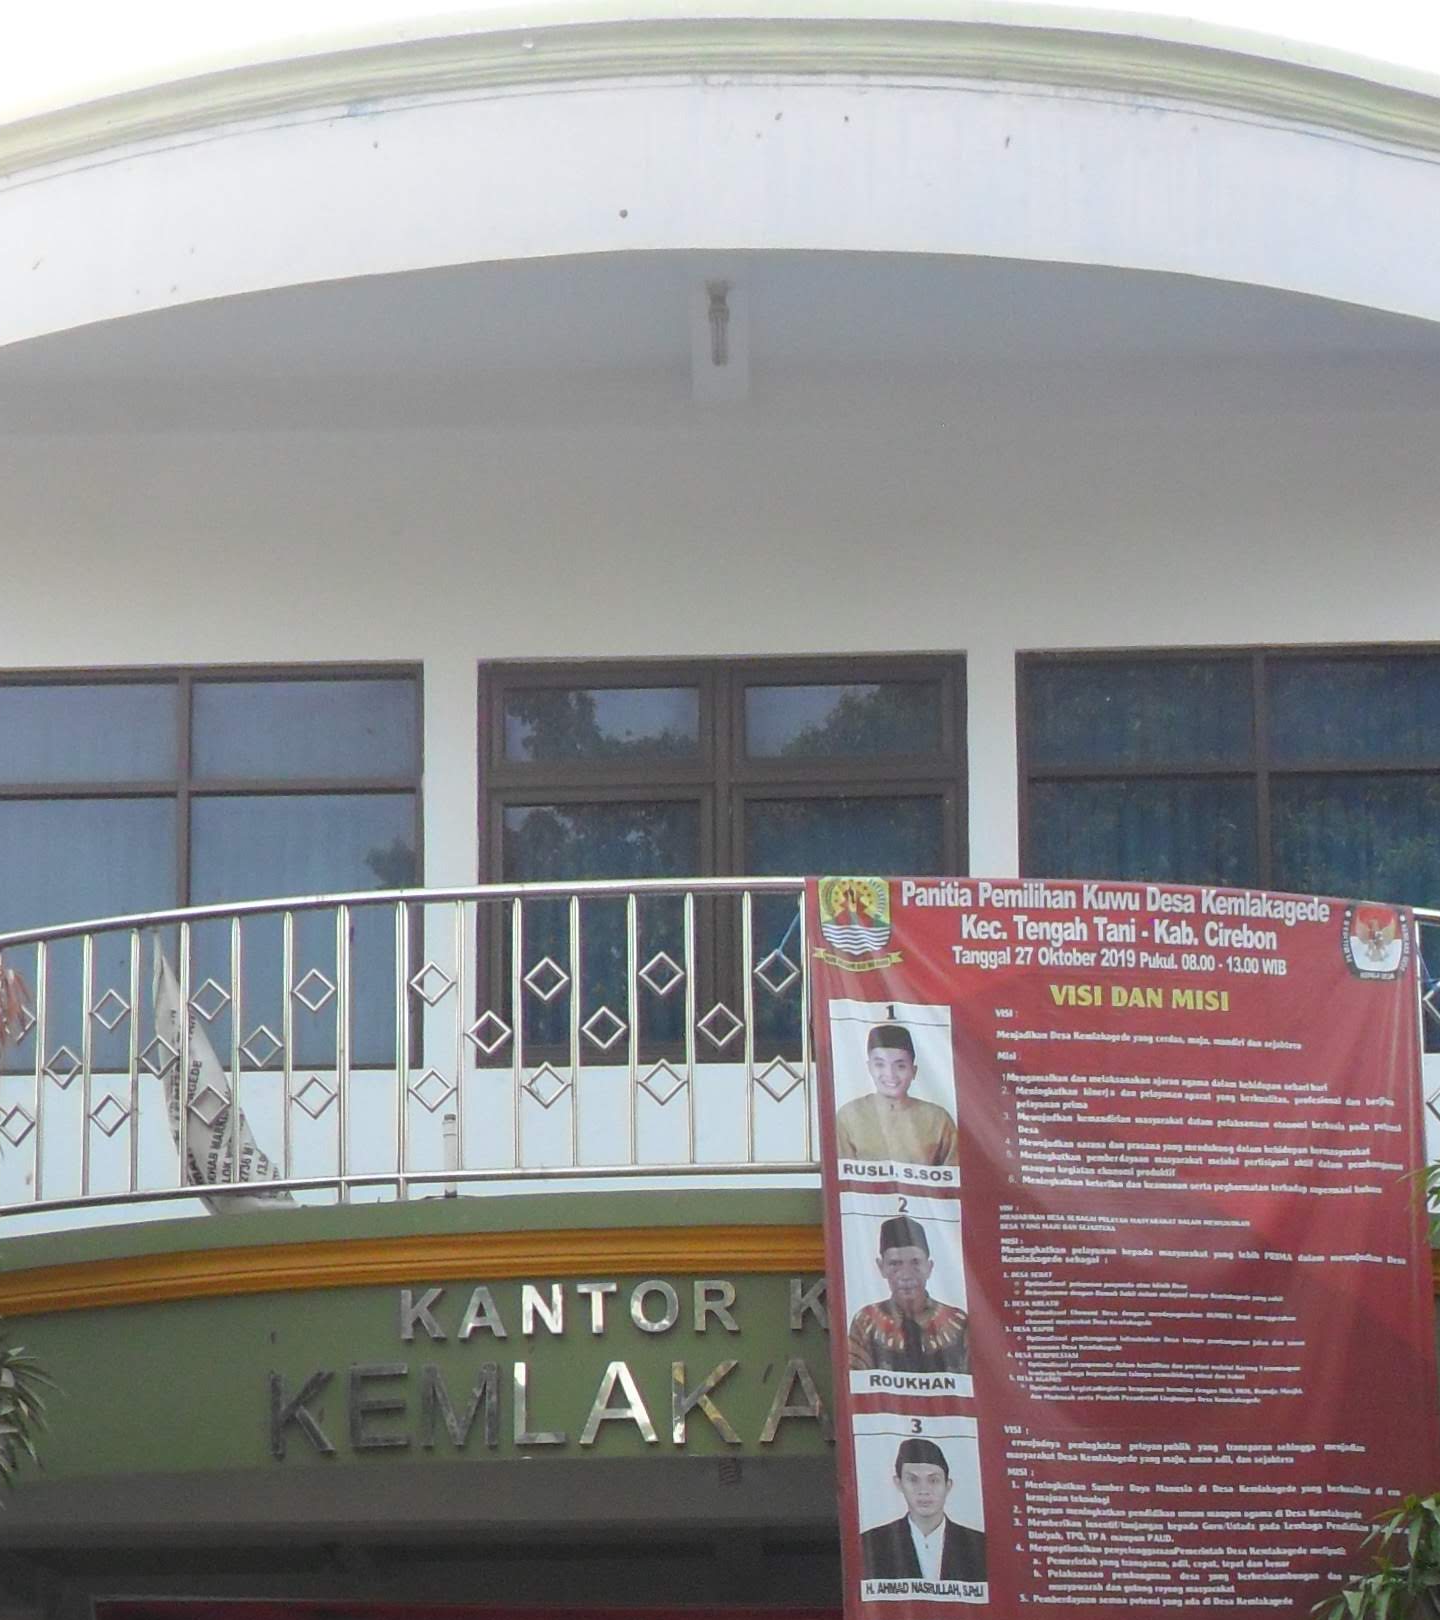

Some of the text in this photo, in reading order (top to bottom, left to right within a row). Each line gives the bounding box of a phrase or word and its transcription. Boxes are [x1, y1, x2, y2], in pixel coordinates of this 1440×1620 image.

[902, 881, 1330, 927] Panitia Pemilihan Kuwu Desa Kemlakagede
[961, 914, 1007, 940] Kec.
[1013, 915, 1088, 947] Tengah
[1093, 917, 1136, 943] Tani
[1154, 918, 1198, 946] Kab.
[1204, 921, 1277, 950] Cirebon
[952, 945, 1010, 969] Tanggal
[1015, 947, 1033, 965] 27
[1038, 947, 1096, 966] Oktober
[1100, 949, 1135, 967] 2019
[1140, 952, 1178, 970] Pukul.
[1181, 954, 1215, 971] 08.00
[1226, 956, 1259, 974] 13.00
[1261, 957, 1287, 976] WIB
[1049, 984, 1229, 1012] VISI DAN MISI
[886, 1004, 897, 1020] 1
[904, 1167, 953, 1182] S.SOS
[898, 1196, 909, 1213] 2
[400, 1280, 740, 1341] KANTOR
[869, 1374, 956, 1390] ROUKHAN
[911, 1418, 923, 1434] 3
[866, 1583, 875, 1594] H.
[877, 1582, 909, 1595] AHMAD
